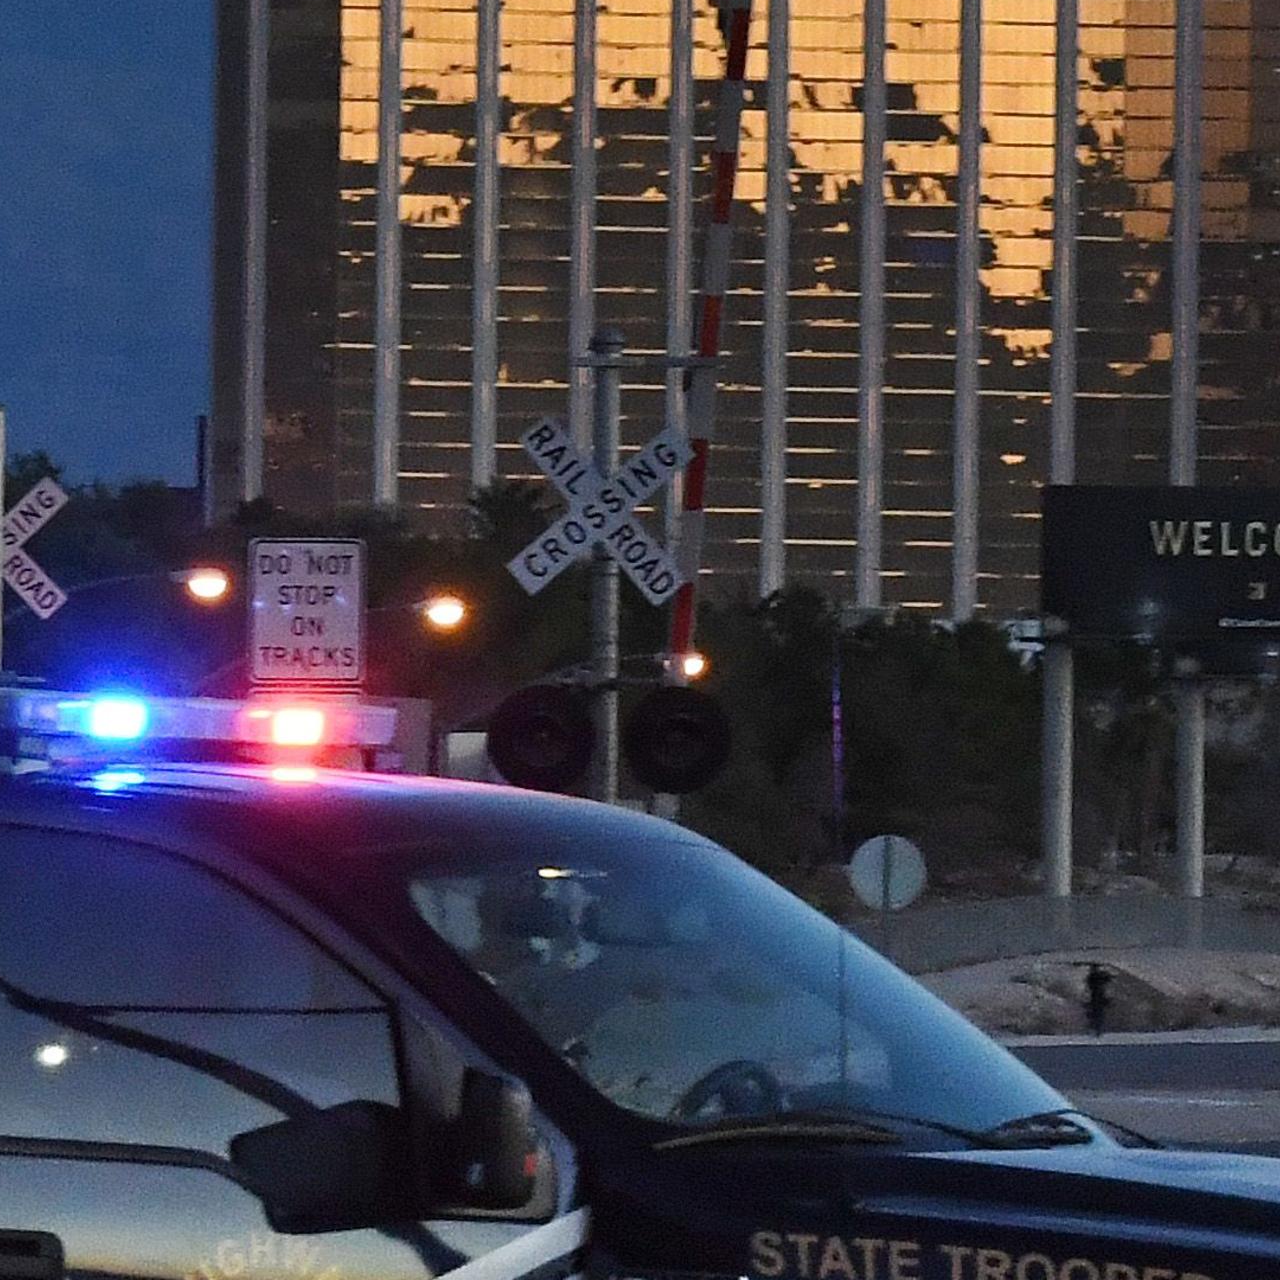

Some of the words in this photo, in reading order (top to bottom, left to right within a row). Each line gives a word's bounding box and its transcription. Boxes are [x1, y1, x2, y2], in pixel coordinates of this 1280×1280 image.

[523, 443, 677, 578] CROSSING
[528, 424, 587, 496] RAIL
[606, 523, 675, 596] ROAD
[258, 554, 292, 575] DO
[307, 554, 354, 576] NOT
[3, 554, 58, 610] ROAD
[278, 585, 337, 605] STOP
[290, 616, 324, 636] ON
[258, 646, 355, 667] TRACKS
